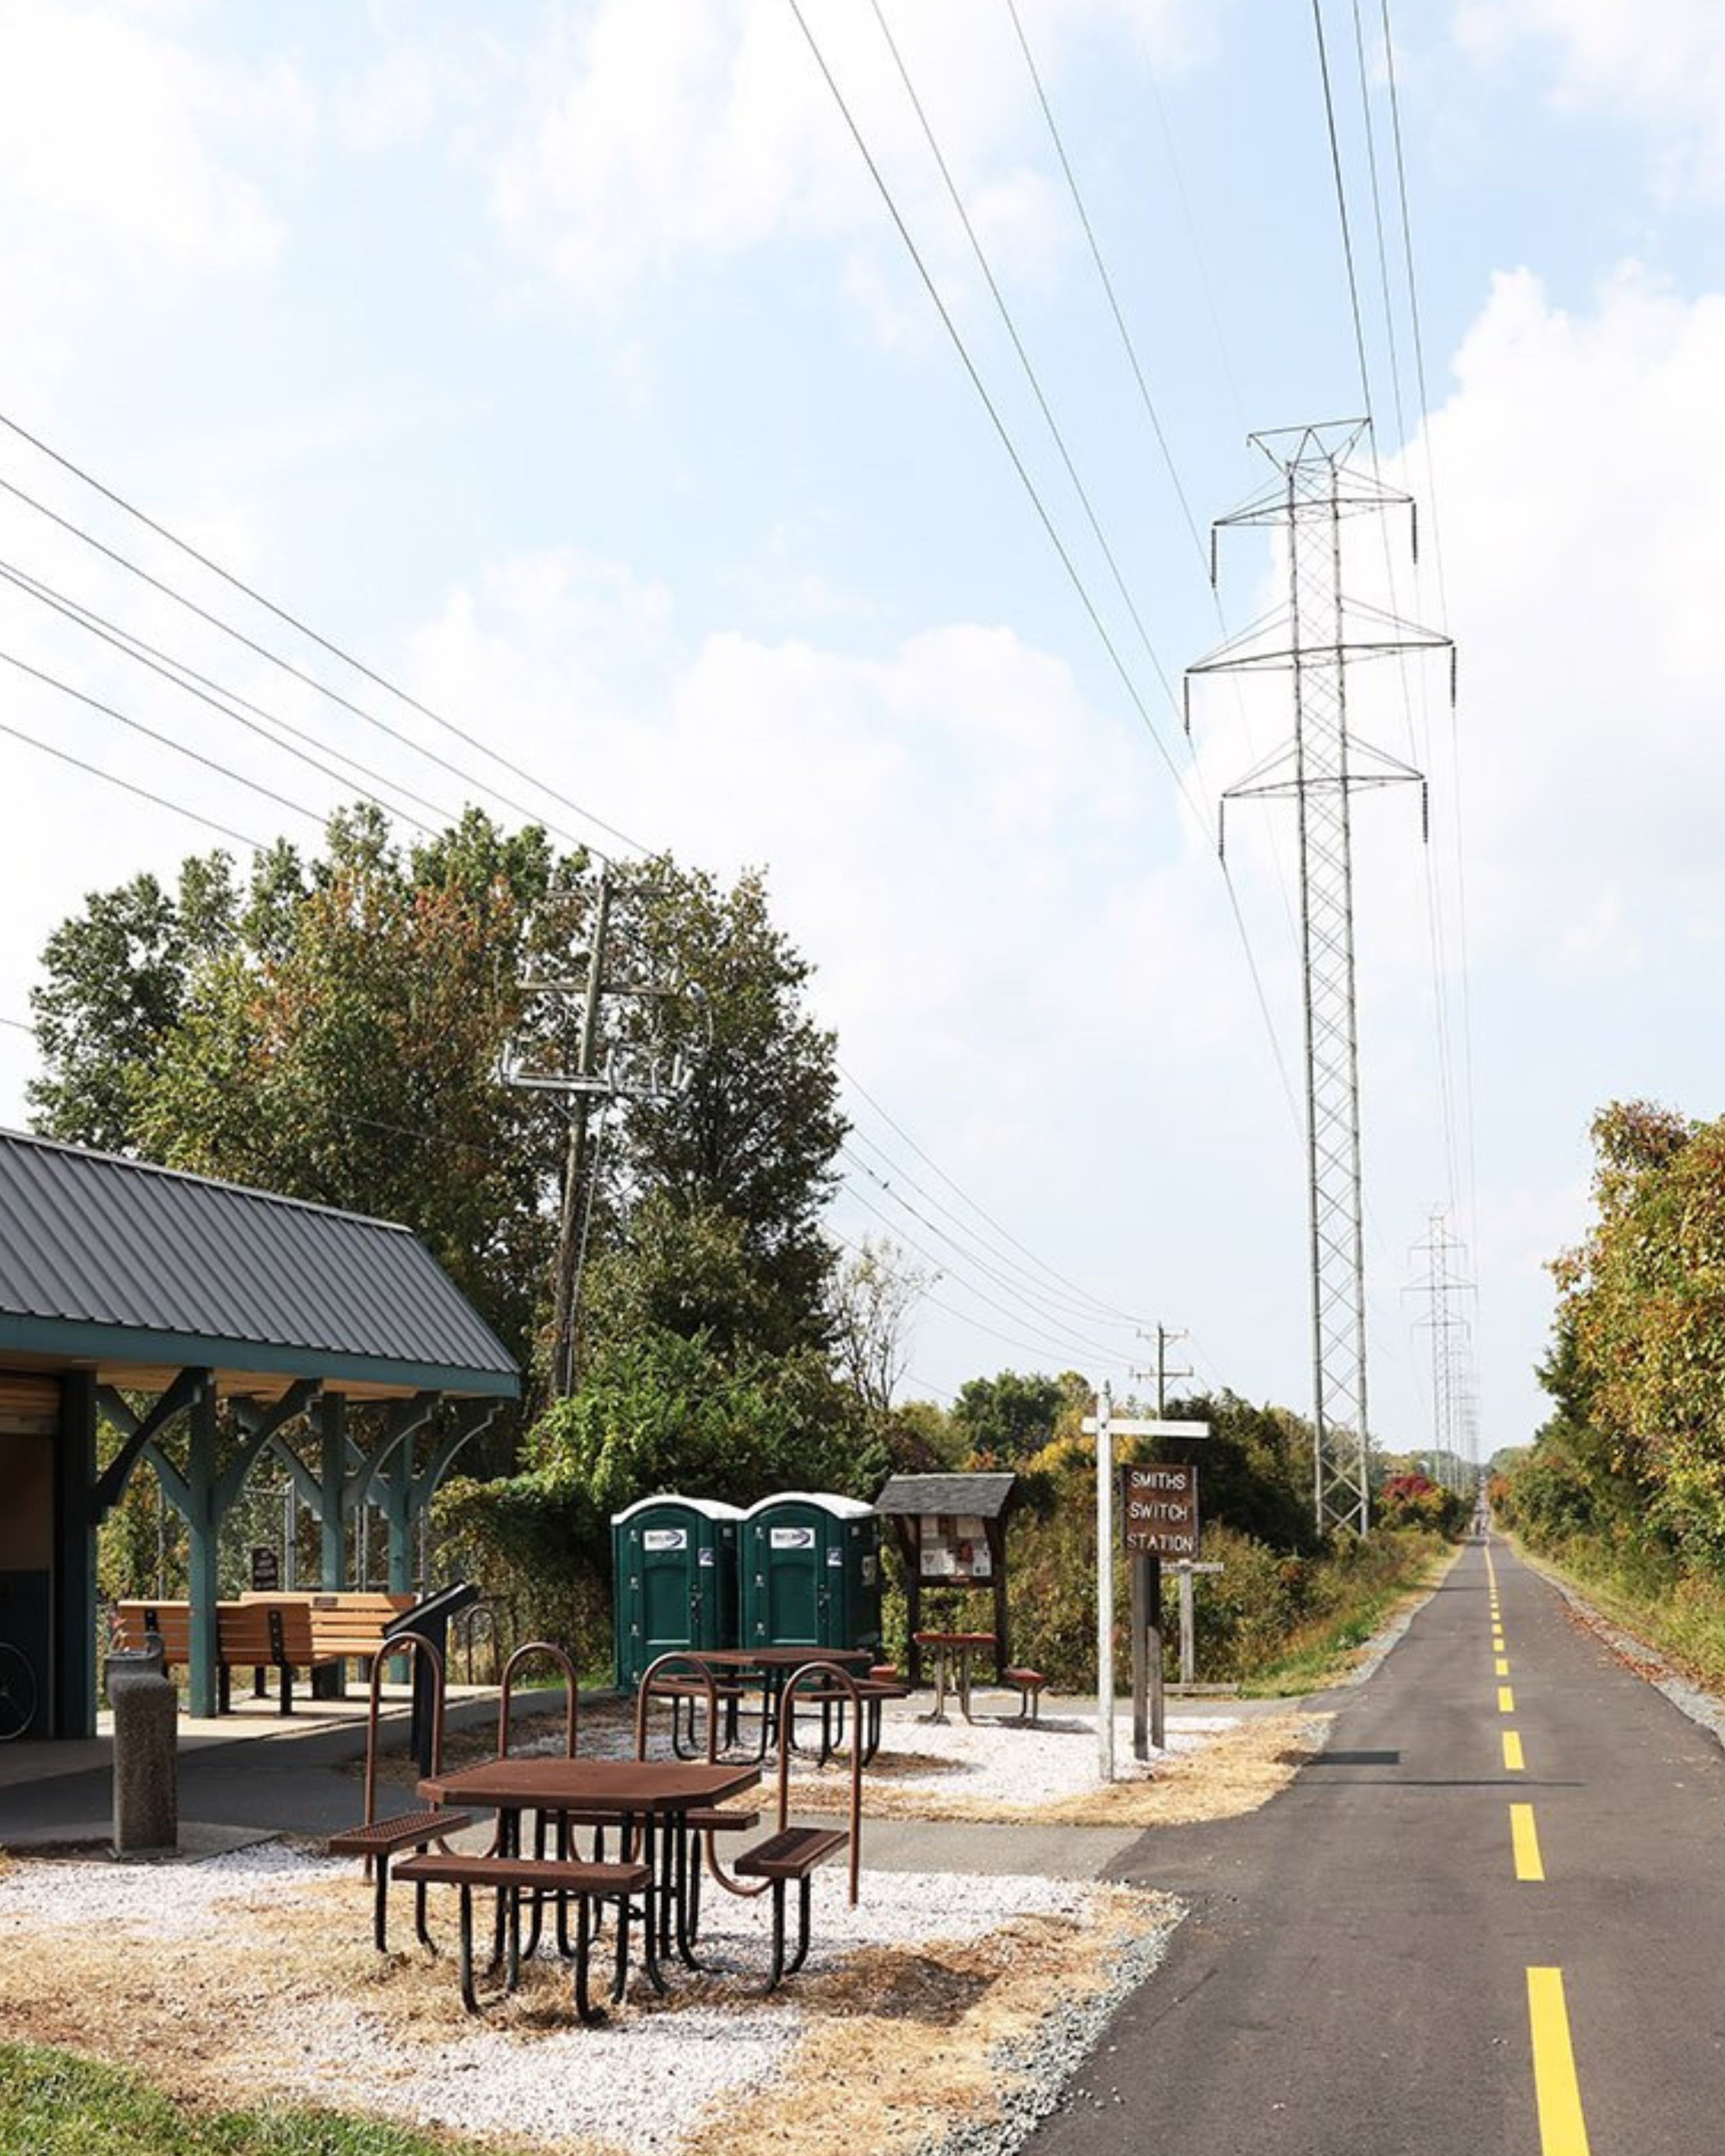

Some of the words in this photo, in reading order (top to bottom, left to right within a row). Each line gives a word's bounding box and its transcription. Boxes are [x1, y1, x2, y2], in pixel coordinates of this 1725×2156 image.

[1131, 1470, 1186, 1490] SMITHS
[1129, 1502, 1187, 1521] SWITCH
[1127, 1534, 1194, 1552] STATION
